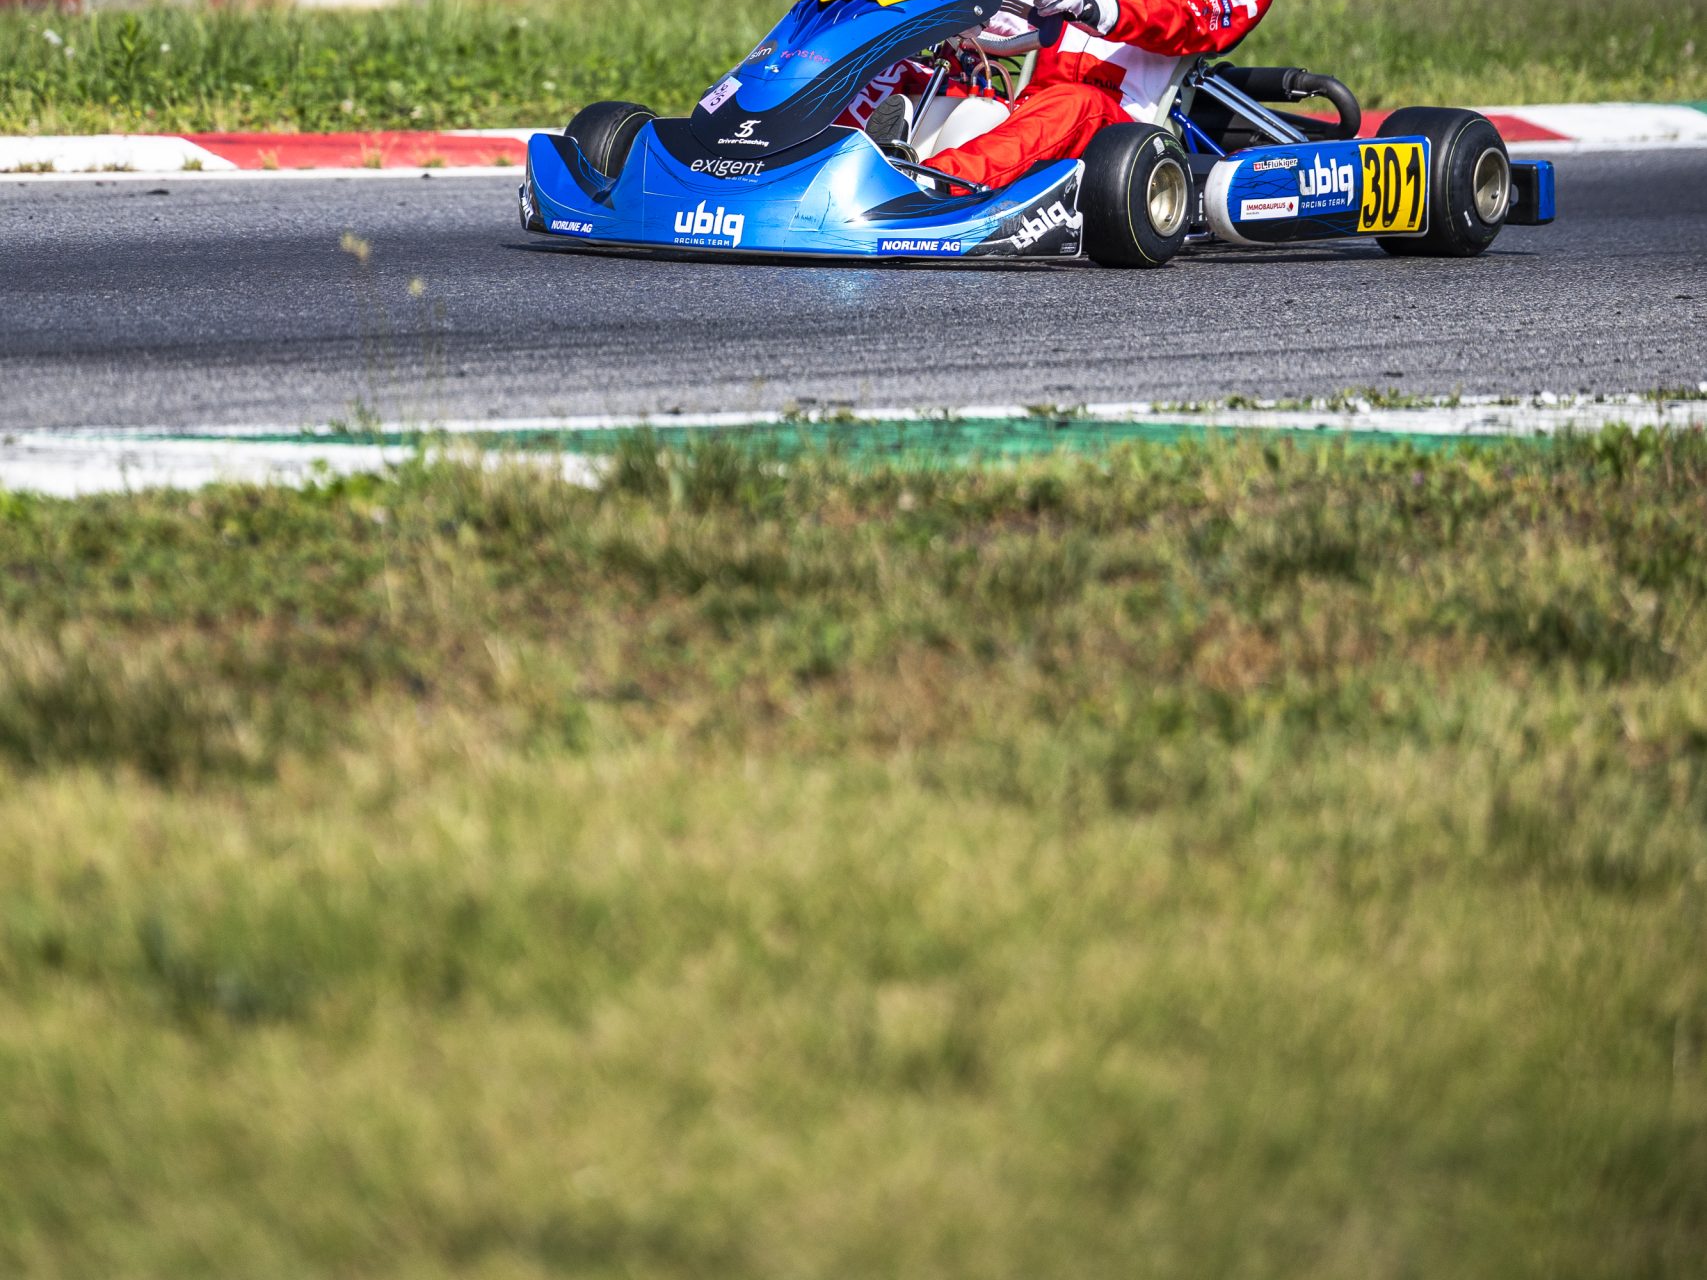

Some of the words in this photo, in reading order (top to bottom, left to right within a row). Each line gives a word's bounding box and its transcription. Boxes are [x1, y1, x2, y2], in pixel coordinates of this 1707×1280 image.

[690, 156, 766, 176] exigent
[1363, 146, 1421, 228] 301
[1246, 202, 1286, 211] IMMOBAUPLUS
[1300, 200, 1327, 209] RACING
[1328, 198, 1346, 207] TEAM
[551, 220, 582, 232] NORLINE
[580, 223, 593, 233] AG
[674, 237, 705, 245] RACING
[707, 238, 730, 246] TEAM
[881, 240, 938, 251] NORLINE
[941, 241, 961, 252] AG
